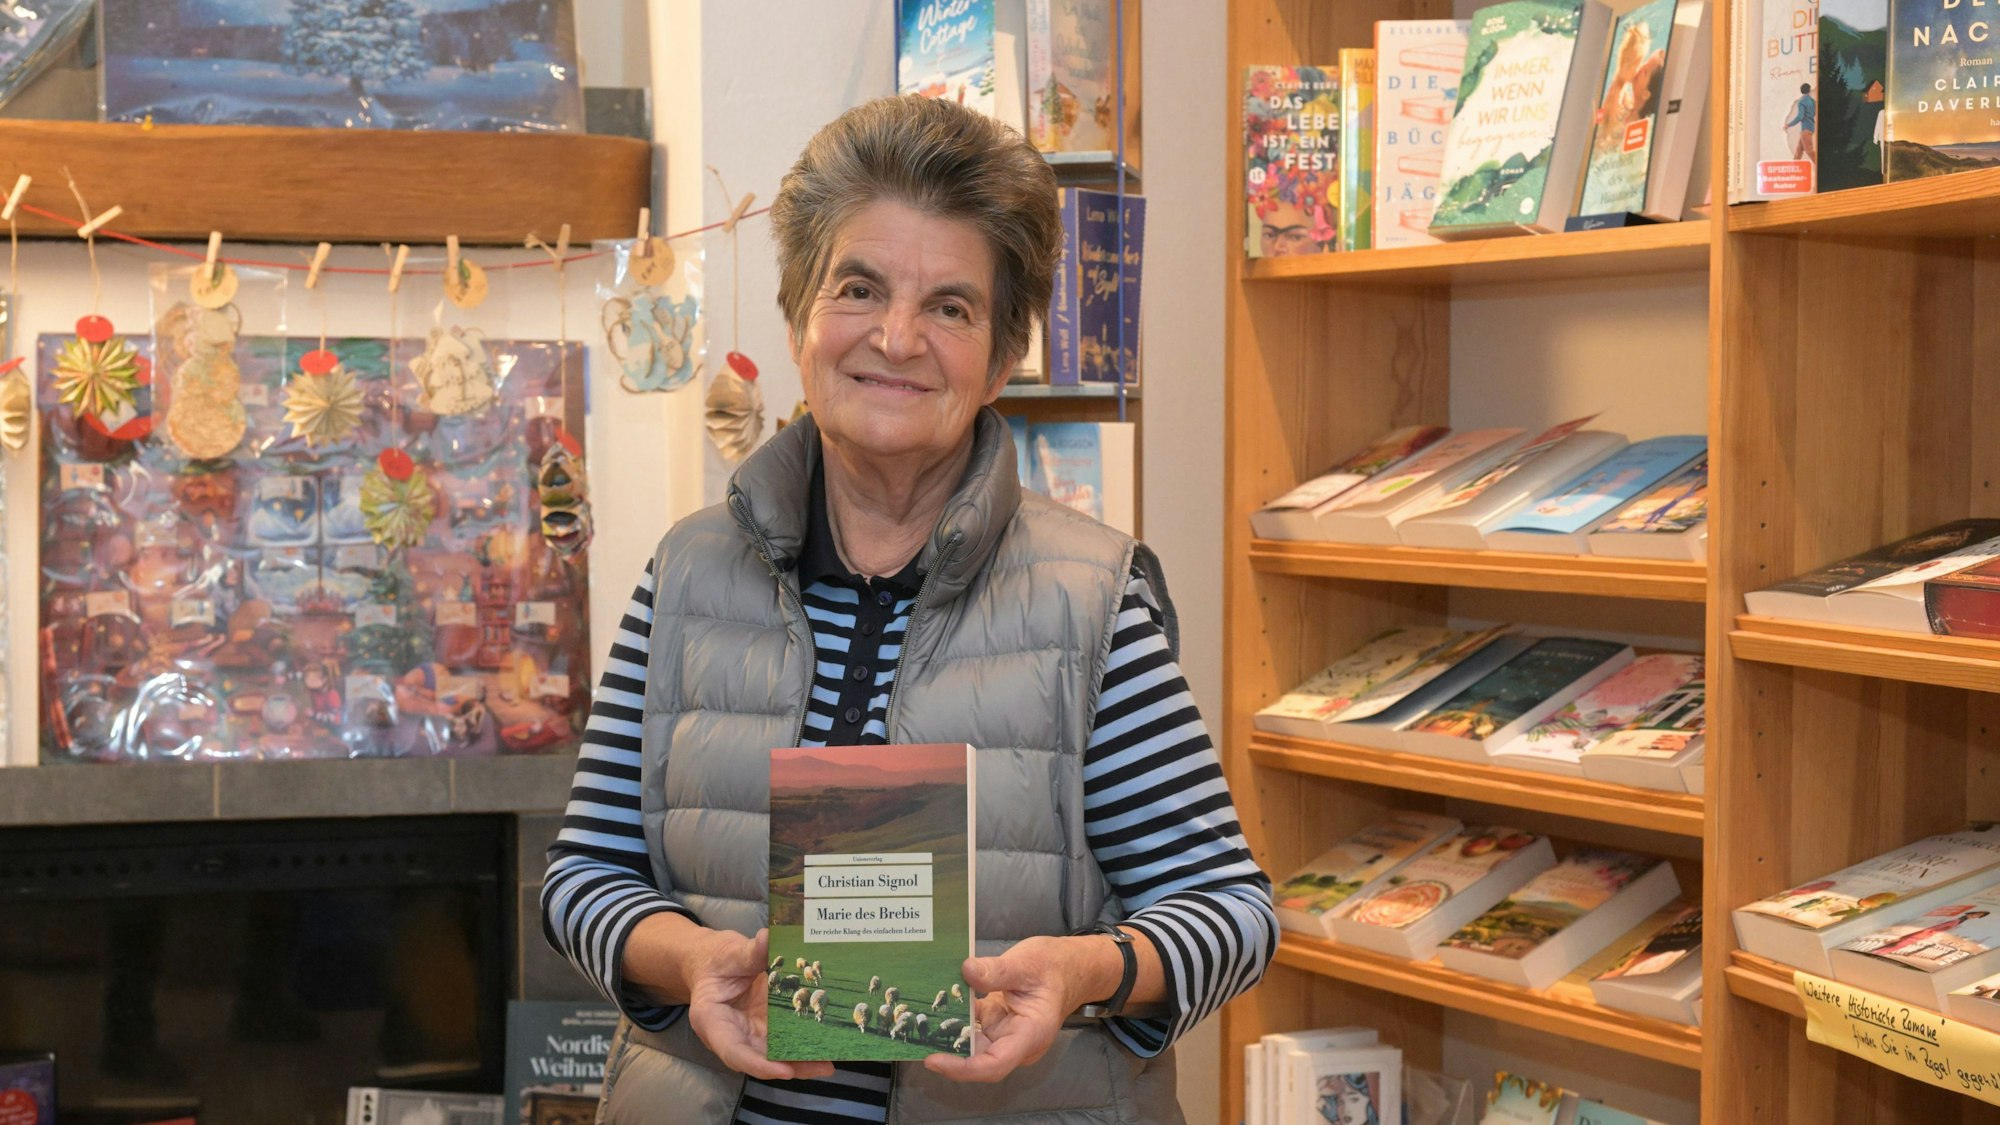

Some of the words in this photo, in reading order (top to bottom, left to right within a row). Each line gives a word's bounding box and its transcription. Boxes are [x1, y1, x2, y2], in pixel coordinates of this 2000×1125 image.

[920, 15, 977, 55] Cottage
[1913, 21, 1989, 47] NAC
[1960, 57, 1993, 67] Roman
[1388, 75, 1438, 90] DIE
[1492, 80, 1545, 101] WENN
[1270, 95, 1304, 110] DAS
[1286, 112, 1340, 131] LEBE
[1478, 107, 1509, 127] WIR
[1511, 102, 1550, 122] UNS
[1262, 134, 1289, 148] IST
[1300, 134, 1330, 149] EIN
[1284, 153, 1337, 171] FEST
[818, 874, 875, 889] Christian
[877, 873, 919, 892] Signol
[816, 907, 853, 921] Marie
[855, 906, 876, 920] des
[879, 905, 921, 920] Brebis
[810, 928, 822, 936] Der
[823, 927, 842, 936] reiche
[843, 927, 861, 937] Klang
[861, 927, 873, 935] des
[873, 926, 904, 935] einfachen
[904, 926, 927, 935] Lebens
[1803, 980, 1842, 1008] Weitere
[1881, 1033, 1900, 1056] Sie
[1904, 1045, 1919, 1064] im
